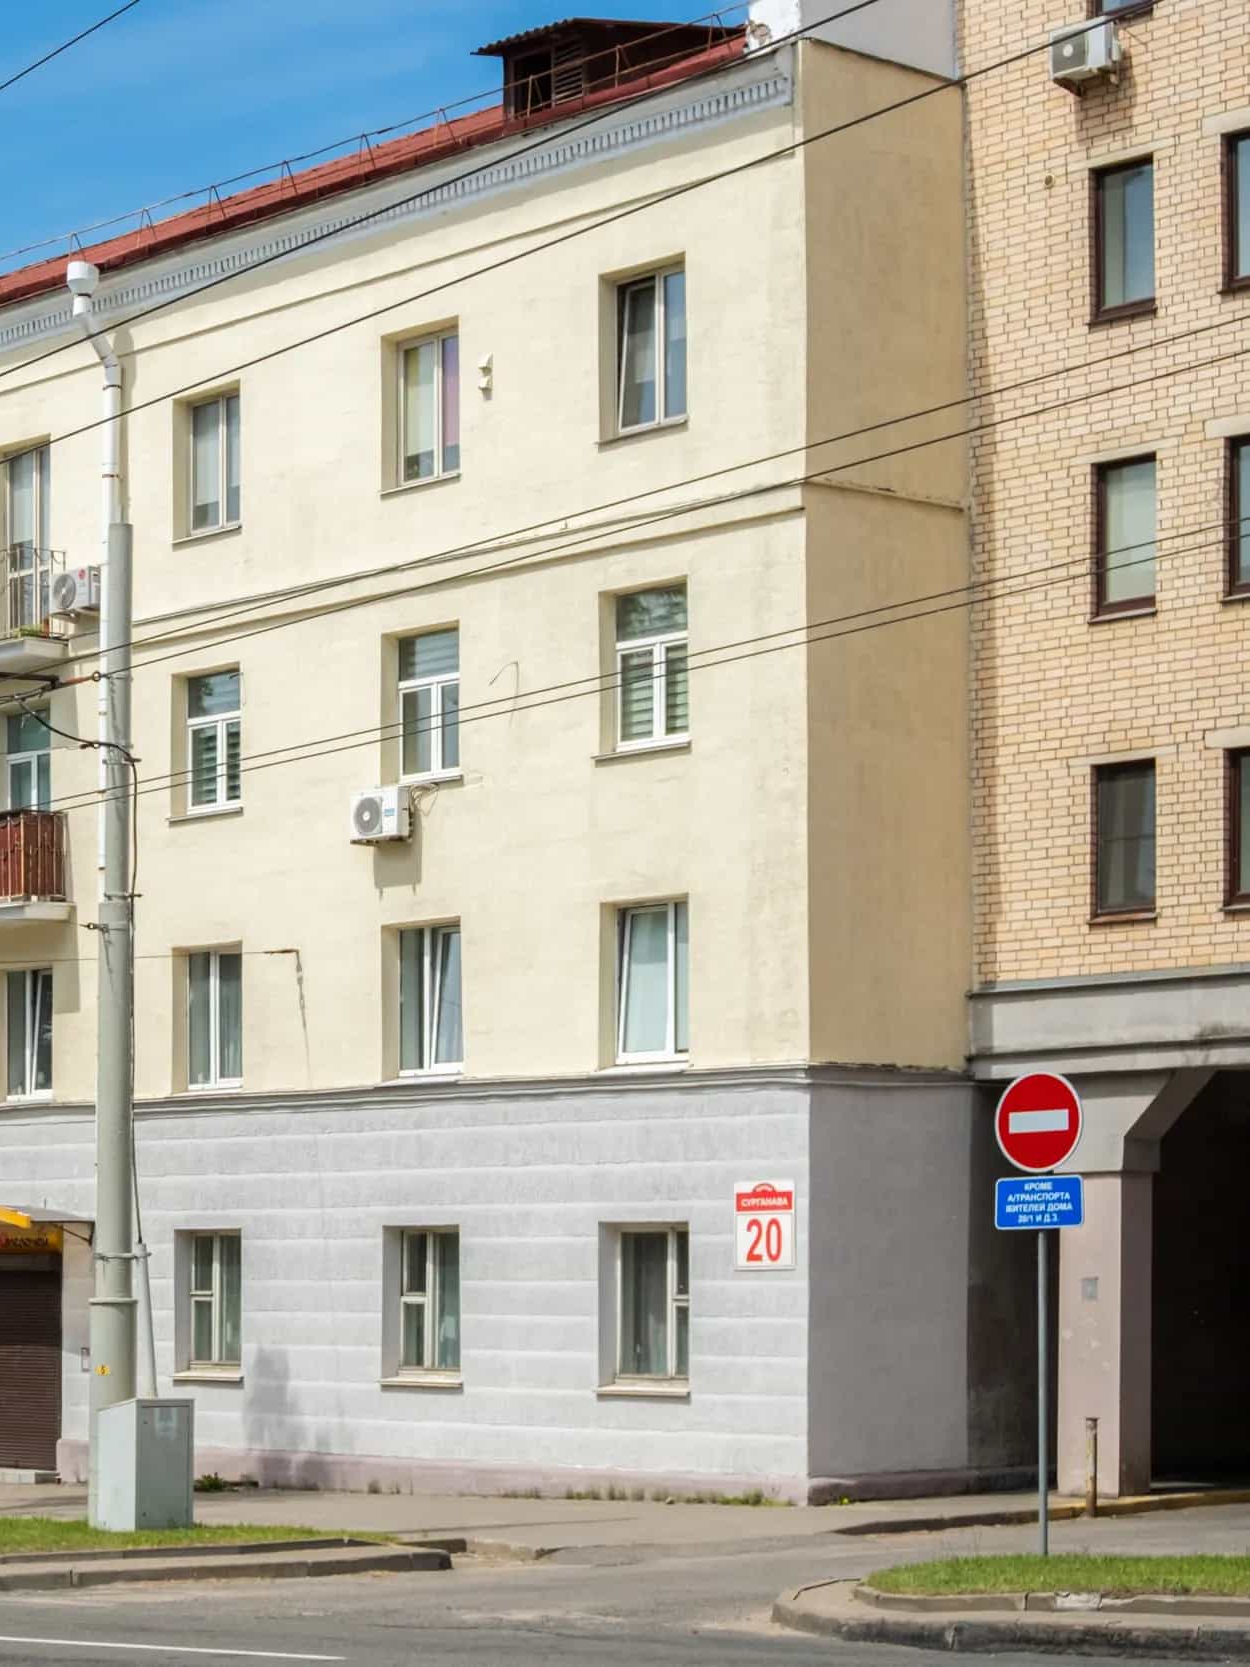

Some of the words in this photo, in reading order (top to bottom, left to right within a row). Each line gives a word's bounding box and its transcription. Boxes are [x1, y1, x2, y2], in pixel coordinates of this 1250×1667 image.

[1024, 1182, 1052, 1191] КРОМЕ
[740, 1196, 789, 1207] СУРГАНАВА
[1007, 1192, 1071, 1202] А/ТРАНСПОРТА
[1005, 1203, 1045, 1213] ЖИТЕЛЕЙ
[1047, 1202, 1073, 1212] ДОМА
[746, 1218, 782, 1262] 20
